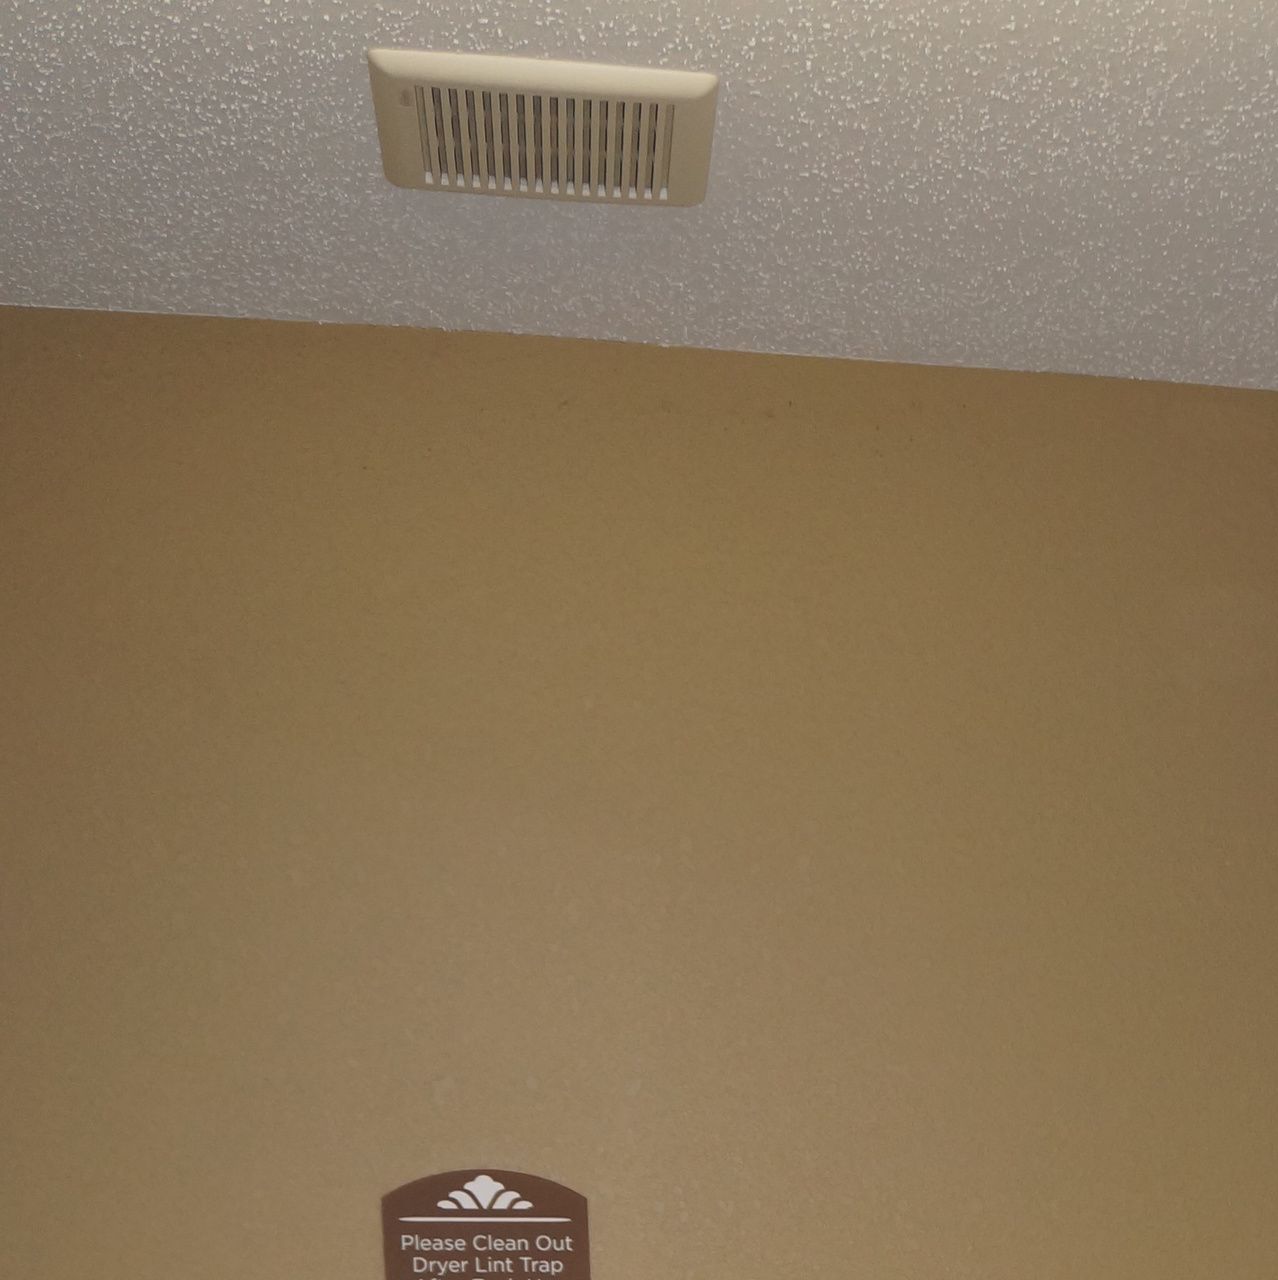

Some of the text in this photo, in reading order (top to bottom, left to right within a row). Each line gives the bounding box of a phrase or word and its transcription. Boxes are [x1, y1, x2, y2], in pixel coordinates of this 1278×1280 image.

[400, 1235, 573, 1250] Please Clean Out
[412, 1257, 564, 1274] Dryer Lint Trap
